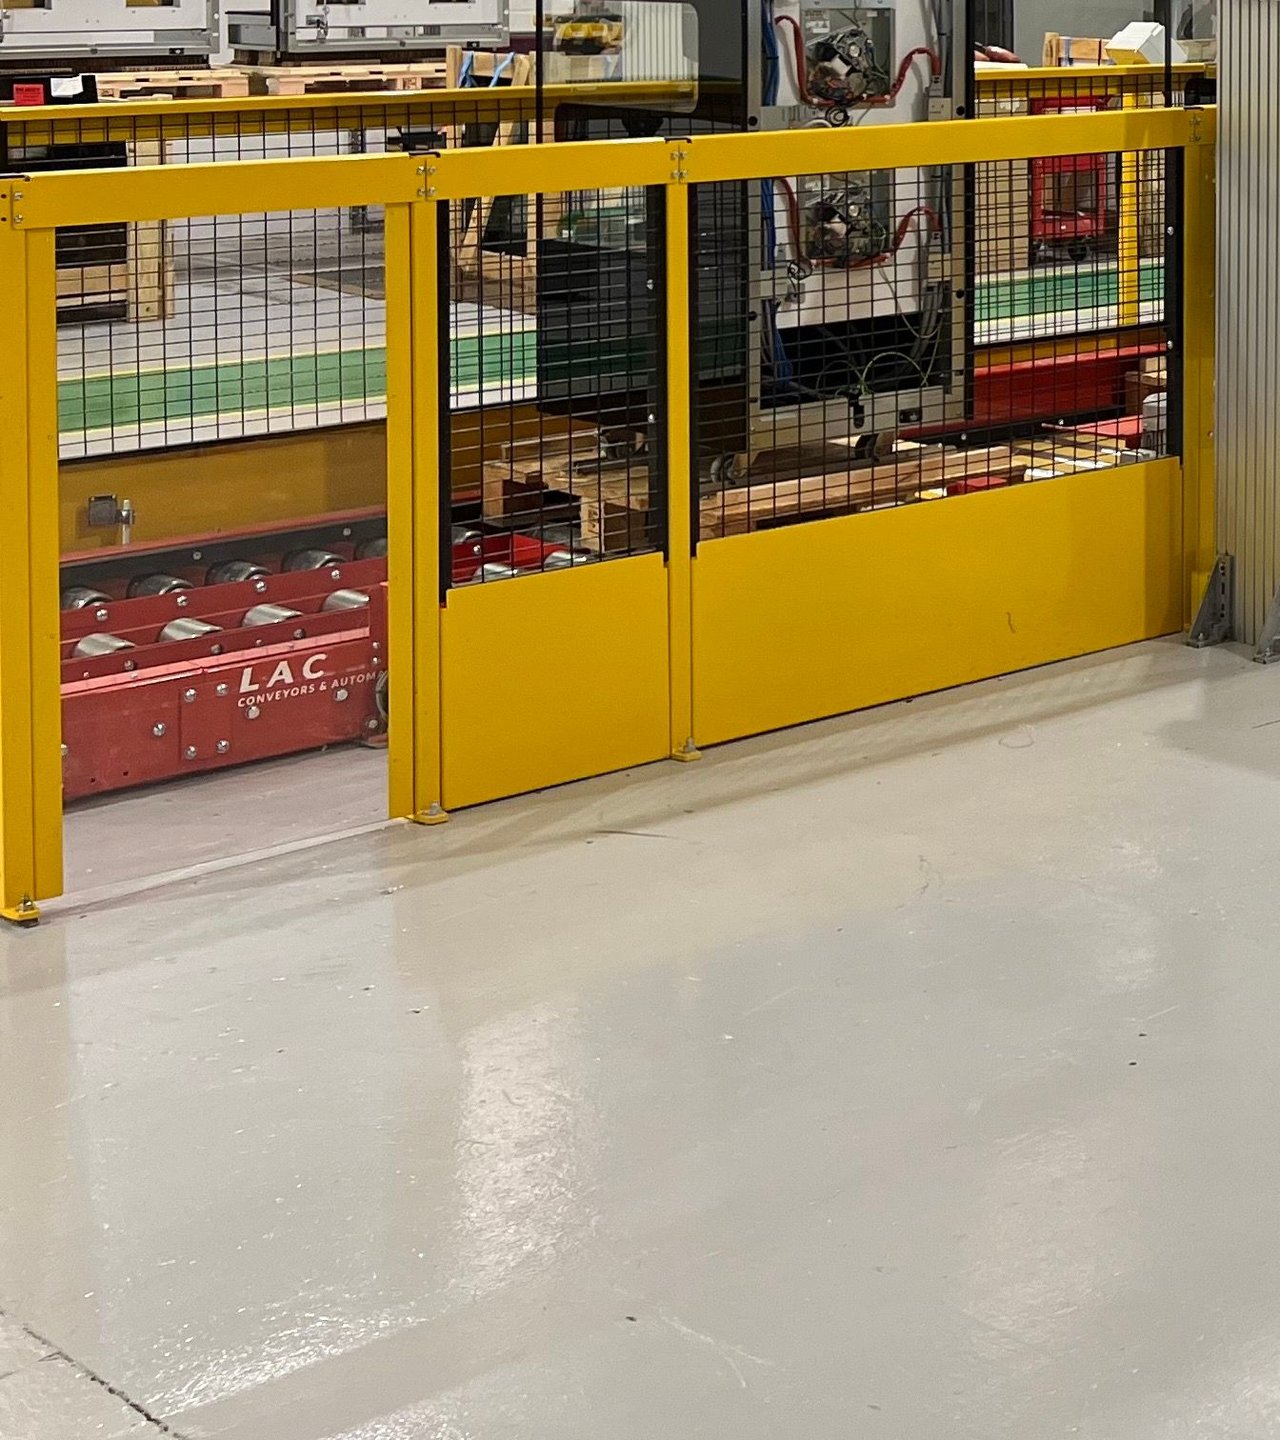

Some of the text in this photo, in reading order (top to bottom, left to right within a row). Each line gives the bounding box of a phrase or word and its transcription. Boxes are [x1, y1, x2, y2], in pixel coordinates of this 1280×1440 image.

[237, 671, 376, 707] CONVEYORS & AUTOM
[239, 653, 327, 694] LAC
